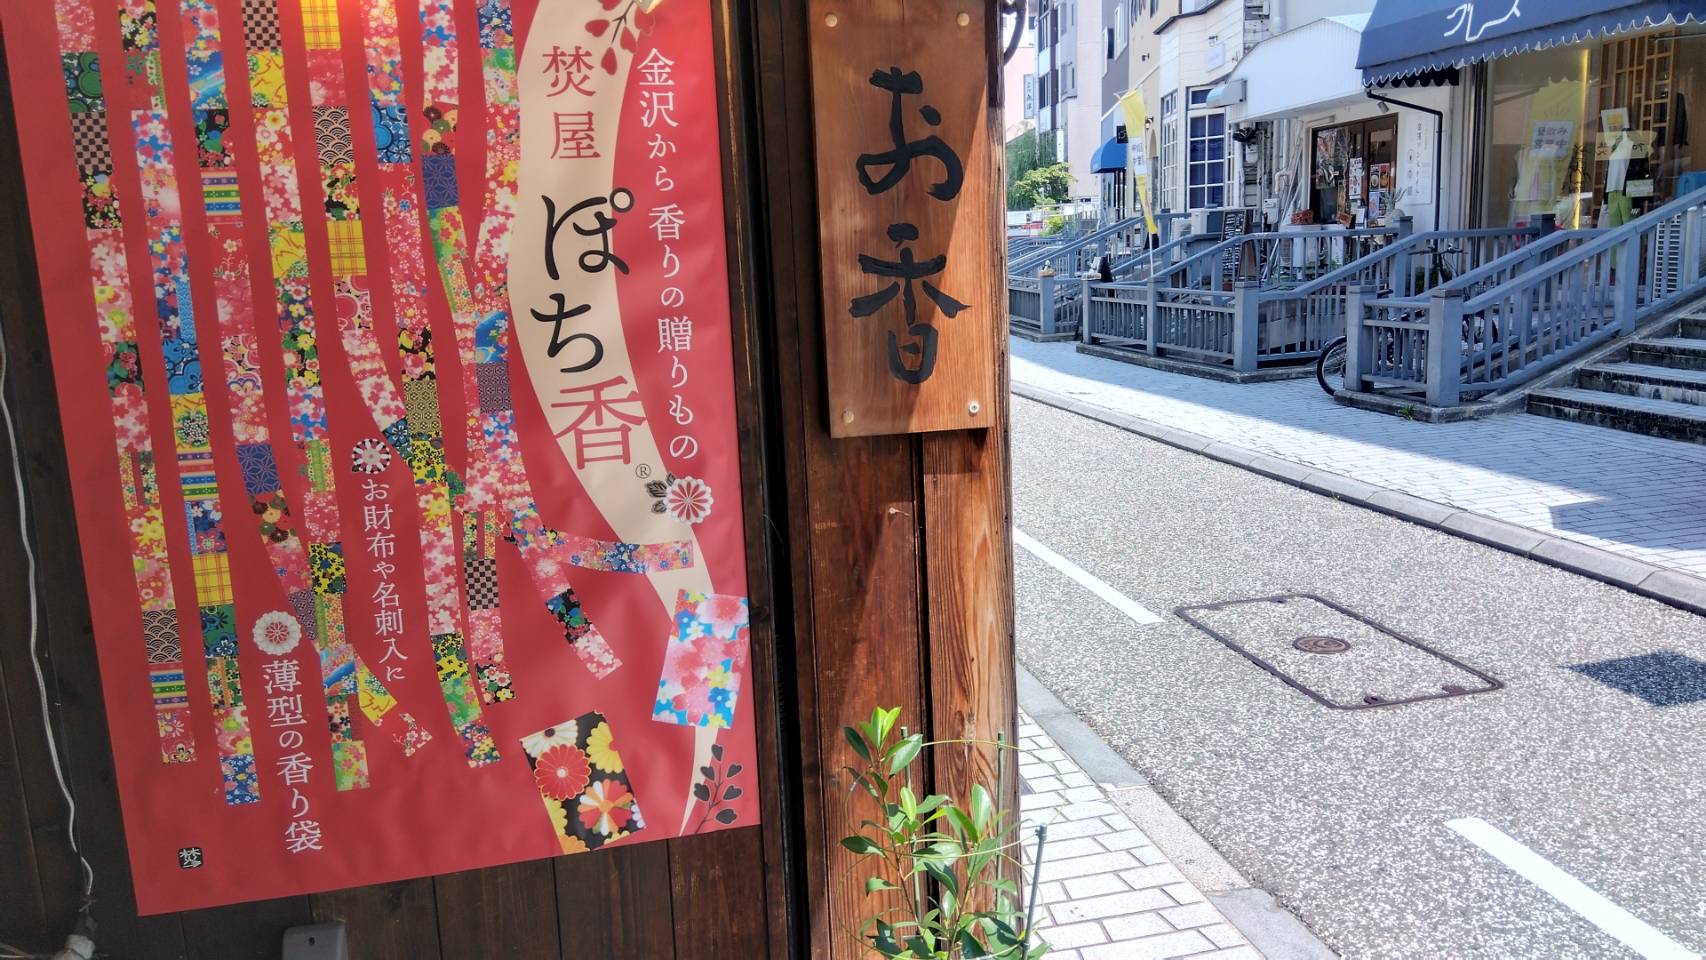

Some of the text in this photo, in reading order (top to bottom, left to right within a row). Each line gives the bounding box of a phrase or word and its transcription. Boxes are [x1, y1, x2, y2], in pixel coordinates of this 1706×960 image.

[542, 45, 601, 160] 焚屋
[530, 187, 648, 470] ぽち香
[636, 47, 698, 460] 金沢から香りの贈りもの
[847, 65, 972, 385] お香
[361, 478, 409, 684] お財布や名刺入に
[261, 658, 326, 855] 薄型の香り袋
